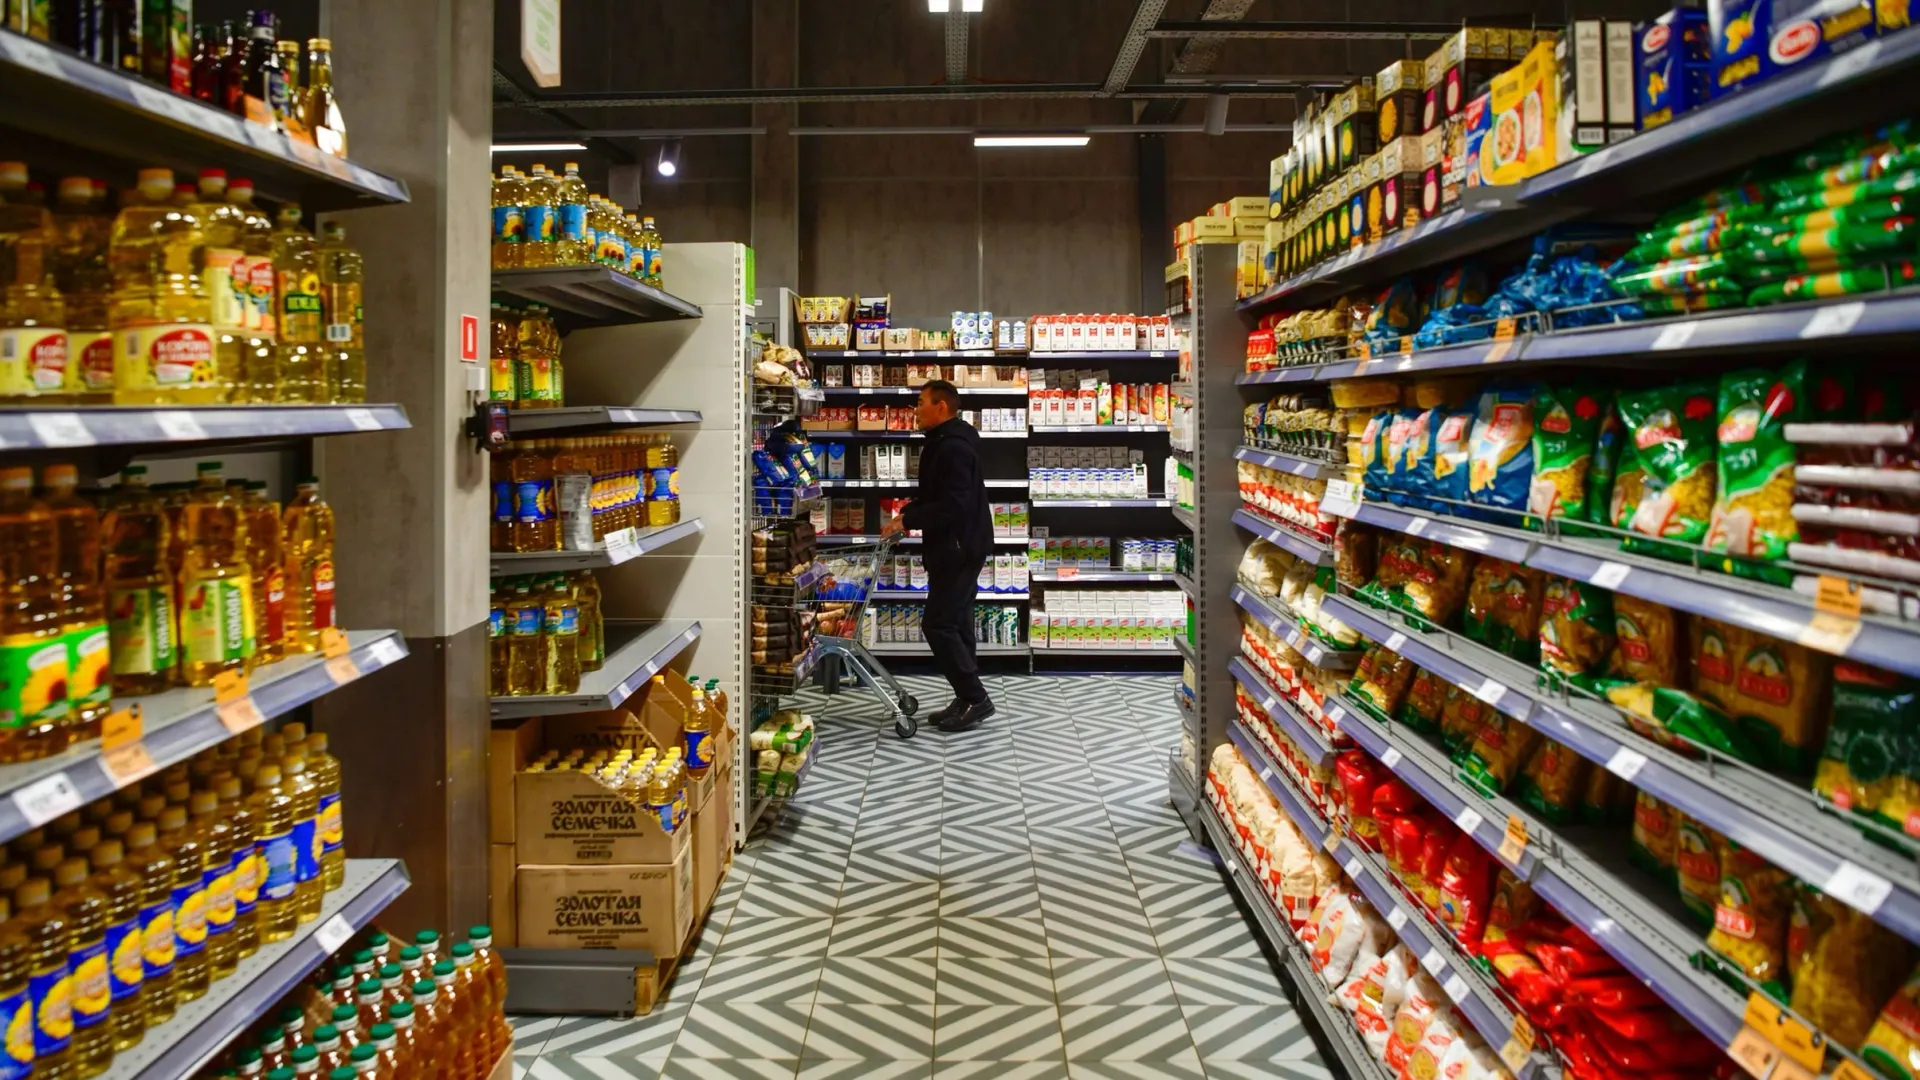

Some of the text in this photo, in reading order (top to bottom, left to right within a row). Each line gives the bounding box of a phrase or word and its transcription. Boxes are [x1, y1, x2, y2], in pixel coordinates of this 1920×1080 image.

[1100, 388, 1110, 396] J7
[227, 590, 241, 649] СЛОБОДА
[156, 598, 168, 658] СЛОБОДА
[551, 800, 636, 815] ЗОЛОТАЯ
[552, 816, 636, 830] СЕМЕЧКА
[554, 895, 642, 912] ЗОЛОТАЯ
[555, 911, 643, 927] СЕМЕЧКА
